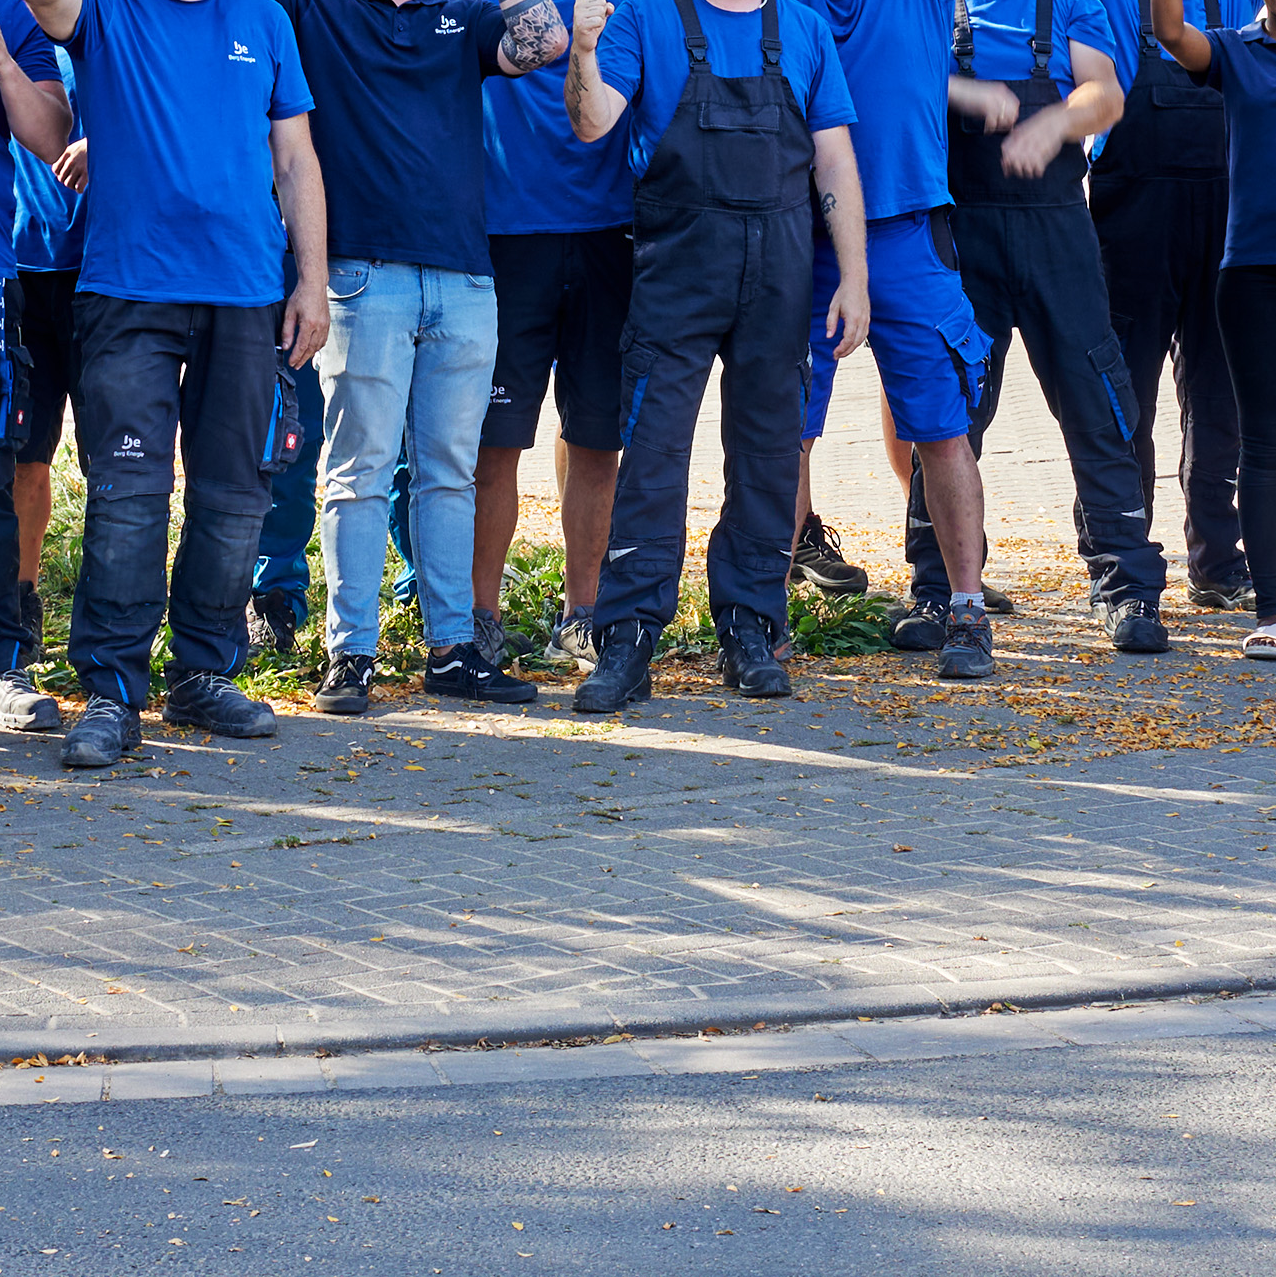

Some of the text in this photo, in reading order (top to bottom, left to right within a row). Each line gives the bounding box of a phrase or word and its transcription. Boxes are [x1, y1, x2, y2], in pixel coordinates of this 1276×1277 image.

[441, 15, 457, 29] be
[234, 41, 249, 55] be
[122, 435, 142, 450] be
